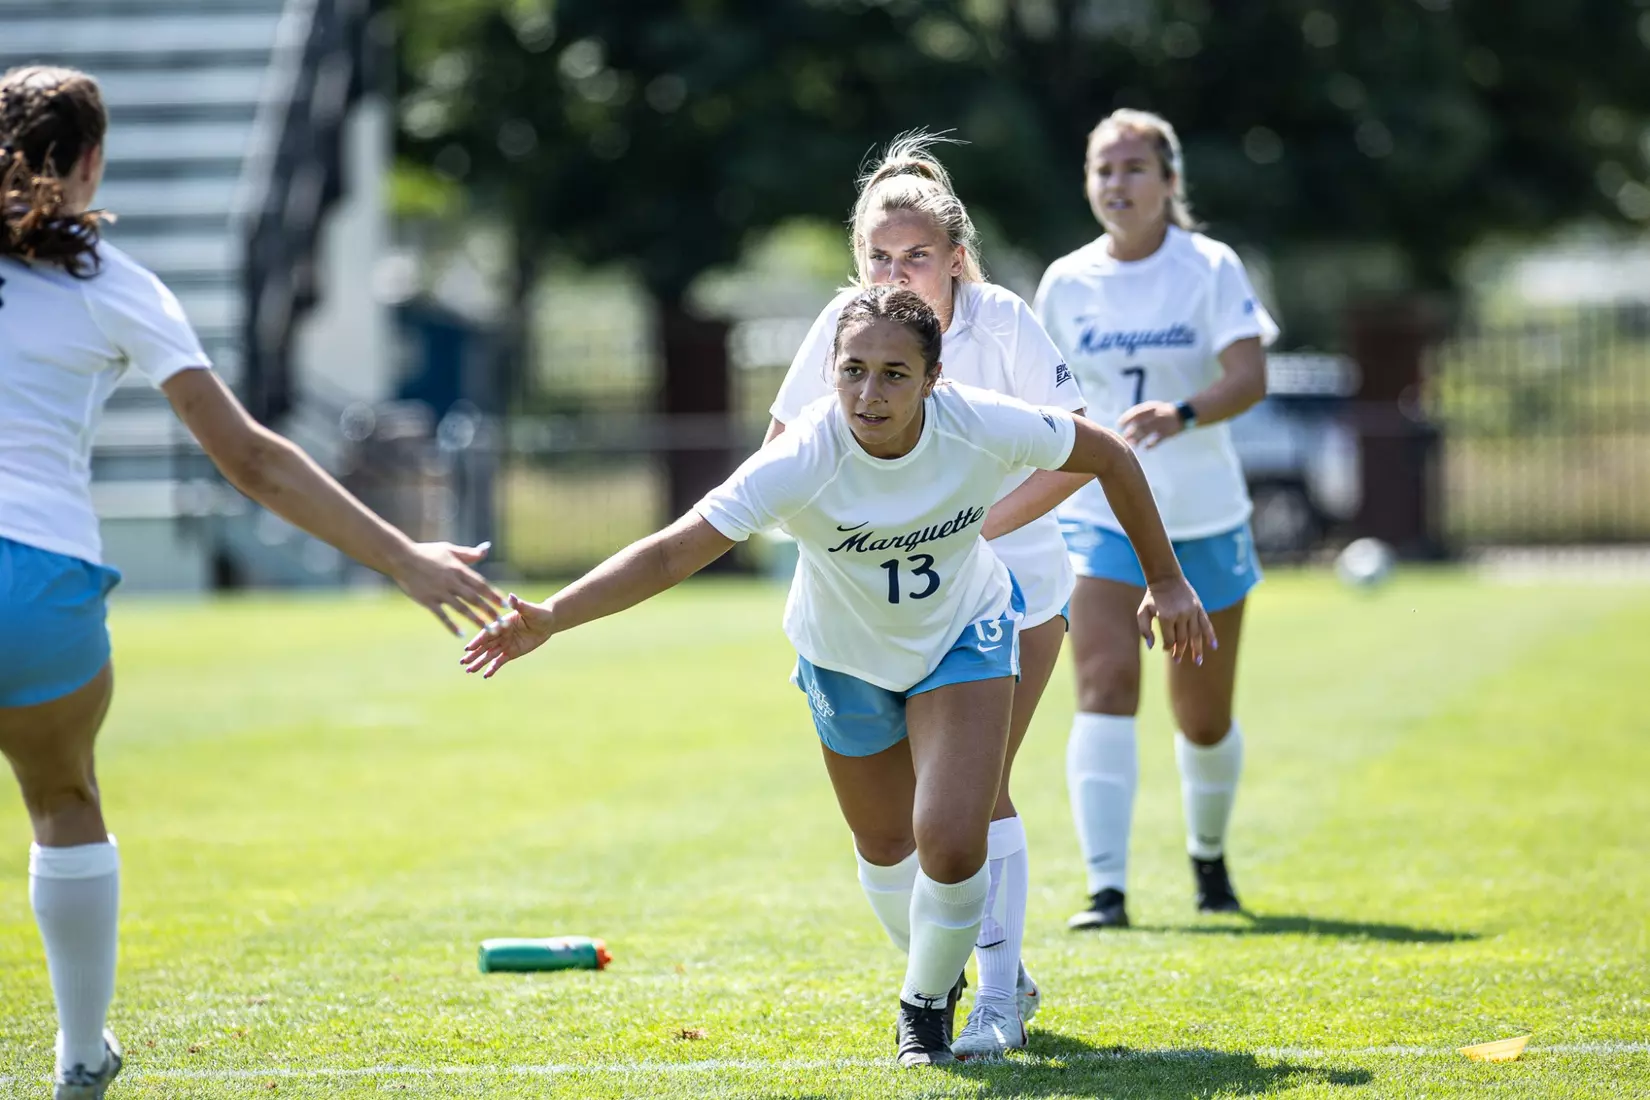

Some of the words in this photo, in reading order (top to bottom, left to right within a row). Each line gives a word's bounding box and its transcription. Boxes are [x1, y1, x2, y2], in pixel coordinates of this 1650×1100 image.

[1077, 322, 1195, 356] Marquette
[1121, 366, 1145, 405] 7
[828, 506, 985, 553] Marquette
[880, 554, 941, 604] 13
[974, 619, 1003, 642] 13
